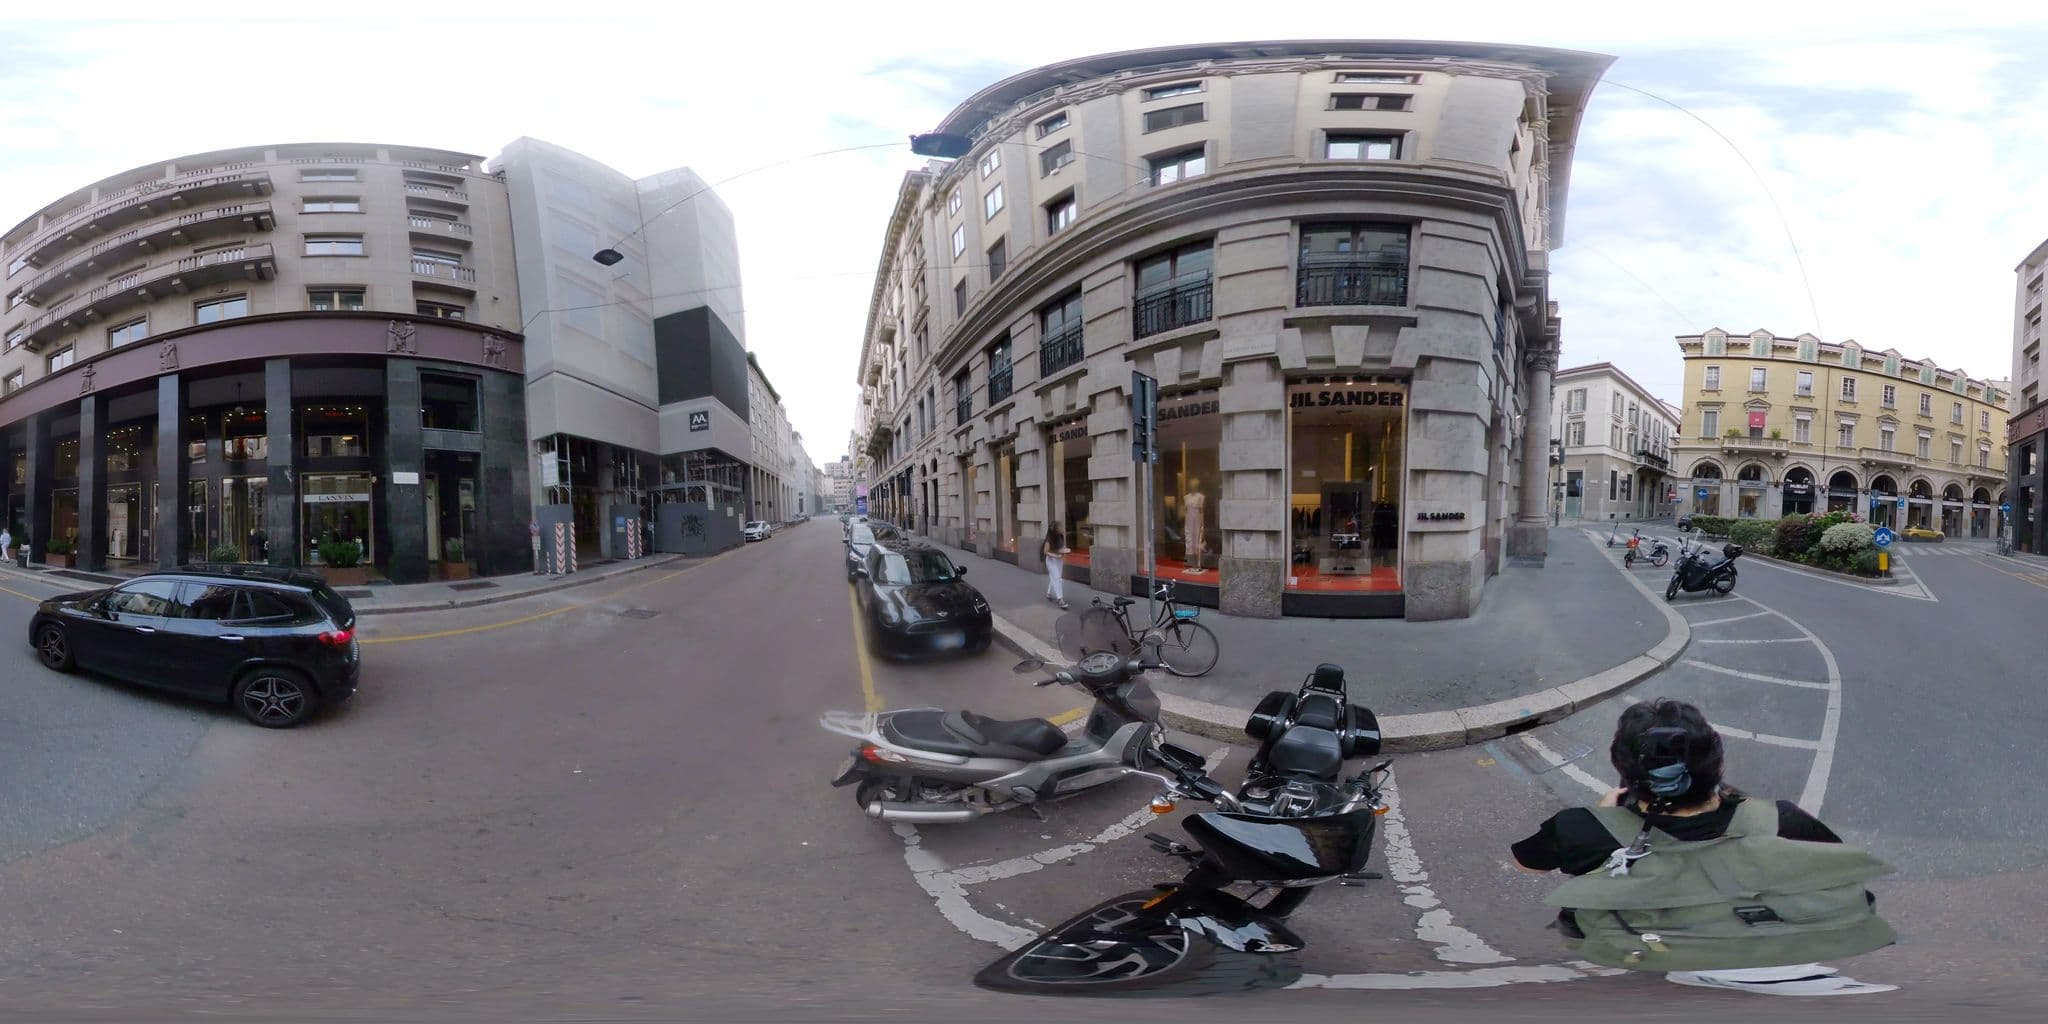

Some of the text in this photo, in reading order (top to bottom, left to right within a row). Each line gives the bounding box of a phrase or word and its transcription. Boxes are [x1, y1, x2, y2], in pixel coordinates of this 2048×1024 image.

[1290, 392, 1403, 408] JIL SANDER
[1417, 512, 1465, 521] JIL SANDER
